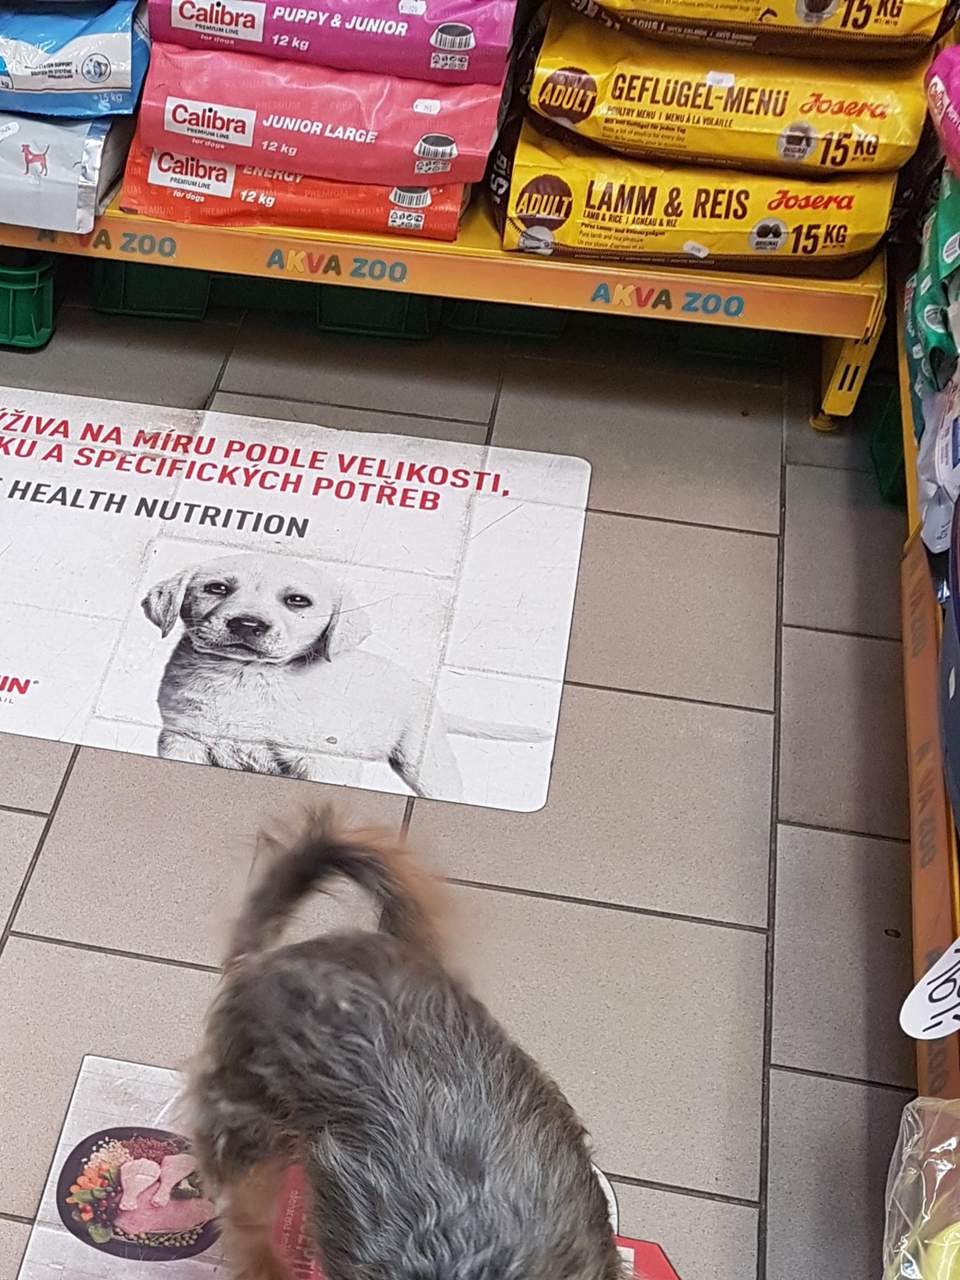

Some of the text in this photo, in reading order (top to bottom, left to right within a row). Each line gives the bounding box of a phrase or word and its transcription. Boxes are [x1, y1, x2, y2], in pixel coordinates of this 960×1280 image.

[178, 1, 256, 30] Calibra
[273, 6, 409, 37] PUPPY & JUNIOR
[840, 0, 905, 30] 15 KG
[271, 34, 309, 51] 12 kg
[539, 83, 597, 113] ADULT
[610, 73, 790, 117] GEFLÜGEL-MENÜ
[799, 92, 888, 120] Josera
[171, 104, 246, 134] Calibra
[186, 127, 230, 140] PREMIUM LINE
[262, 114, 378, 144] JUNIOR LARGE
[261, 140, 298, 156] 12 kg
[820, 130, 880, 167] 15 KG
[157, 152, 227, 183] Calibra
[170, 177, 211, 190] PREMIUM LINE
[173, 189, 205, 203] for dogs
[240, 190, 276, 208] 12 kg
[516, 192, 573, 220] ADULT
[584, 180, 750, 220] LAMM & REIS
[767, 189, 856, 212] Josera
[583, 209, 600, 221] LAMB
[607, 213, 623, 225] RICE
[631, 215, 657, 227] AGNEAU
[665, 218, 678, 228] RIZ
[120, 232, 177, 258] ZOO
[791, 223, 848, 254] 15 KG
[266, 248, 407, 283] AKVA ZOO
[591, 282, 745, 317] AKVA ZOO
[80, 422, 122, 447] NA
[132, 427, 218, 456] MÍRU
[223, 438, 329, 471] PODLE
[337, 453, 511, 497] VELIKOSTI,
[41, 443, 65, 463] A
[73, 446, 308, 495] SPECIFICKÝCH
[312, 476, 442, 511] POTŘEB
[6, 479, 127, 514] HEALTH
[134, 496, 310, 539] NUTRITION
